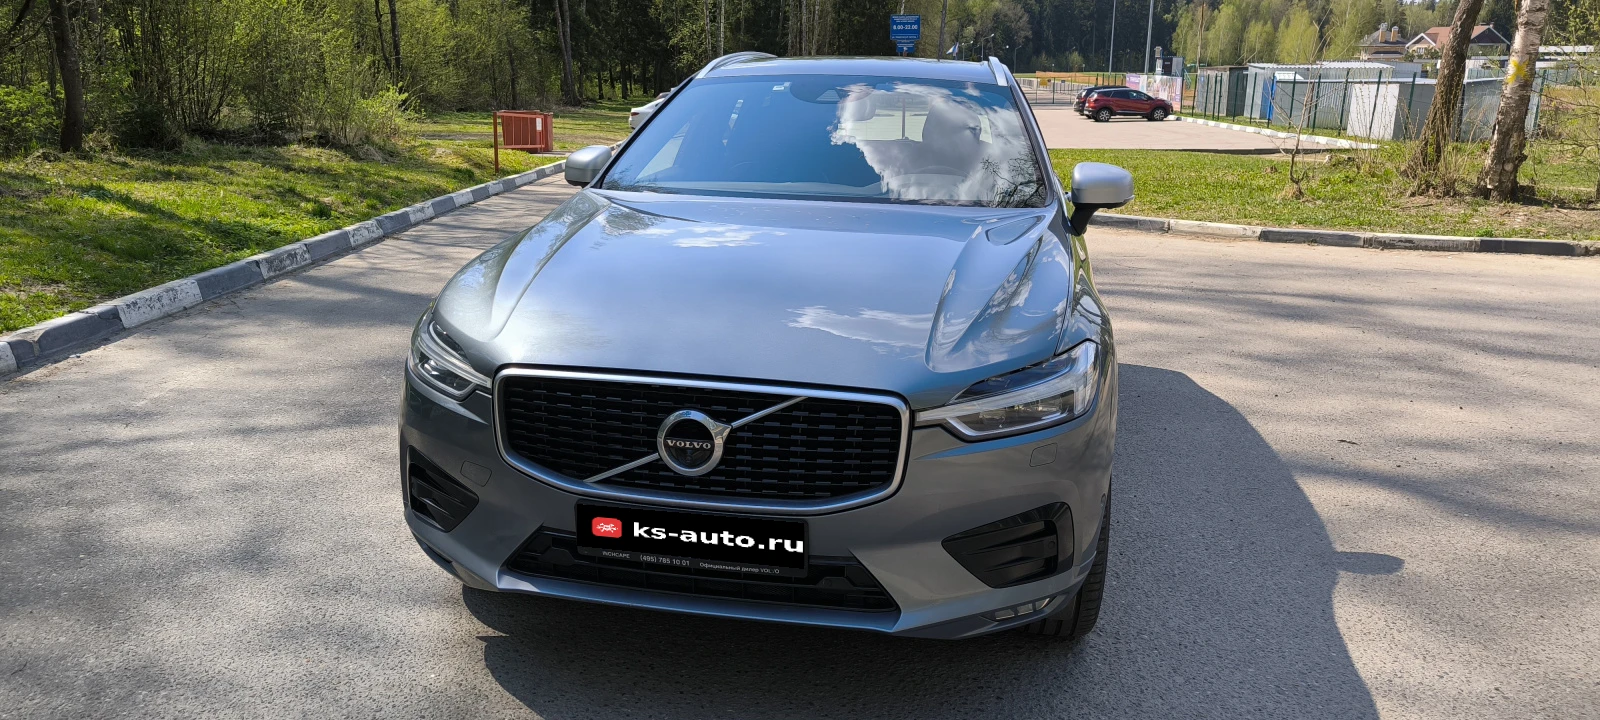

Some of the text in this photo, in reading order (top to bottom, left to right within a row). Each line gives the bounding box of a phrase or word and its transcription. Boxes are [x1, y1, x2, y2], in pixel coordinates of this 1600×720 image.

[666, 439, 712, 449] VOLVO
[640, 554, 657, 562] (495)
[699, 562, 741, 571] Официальный
